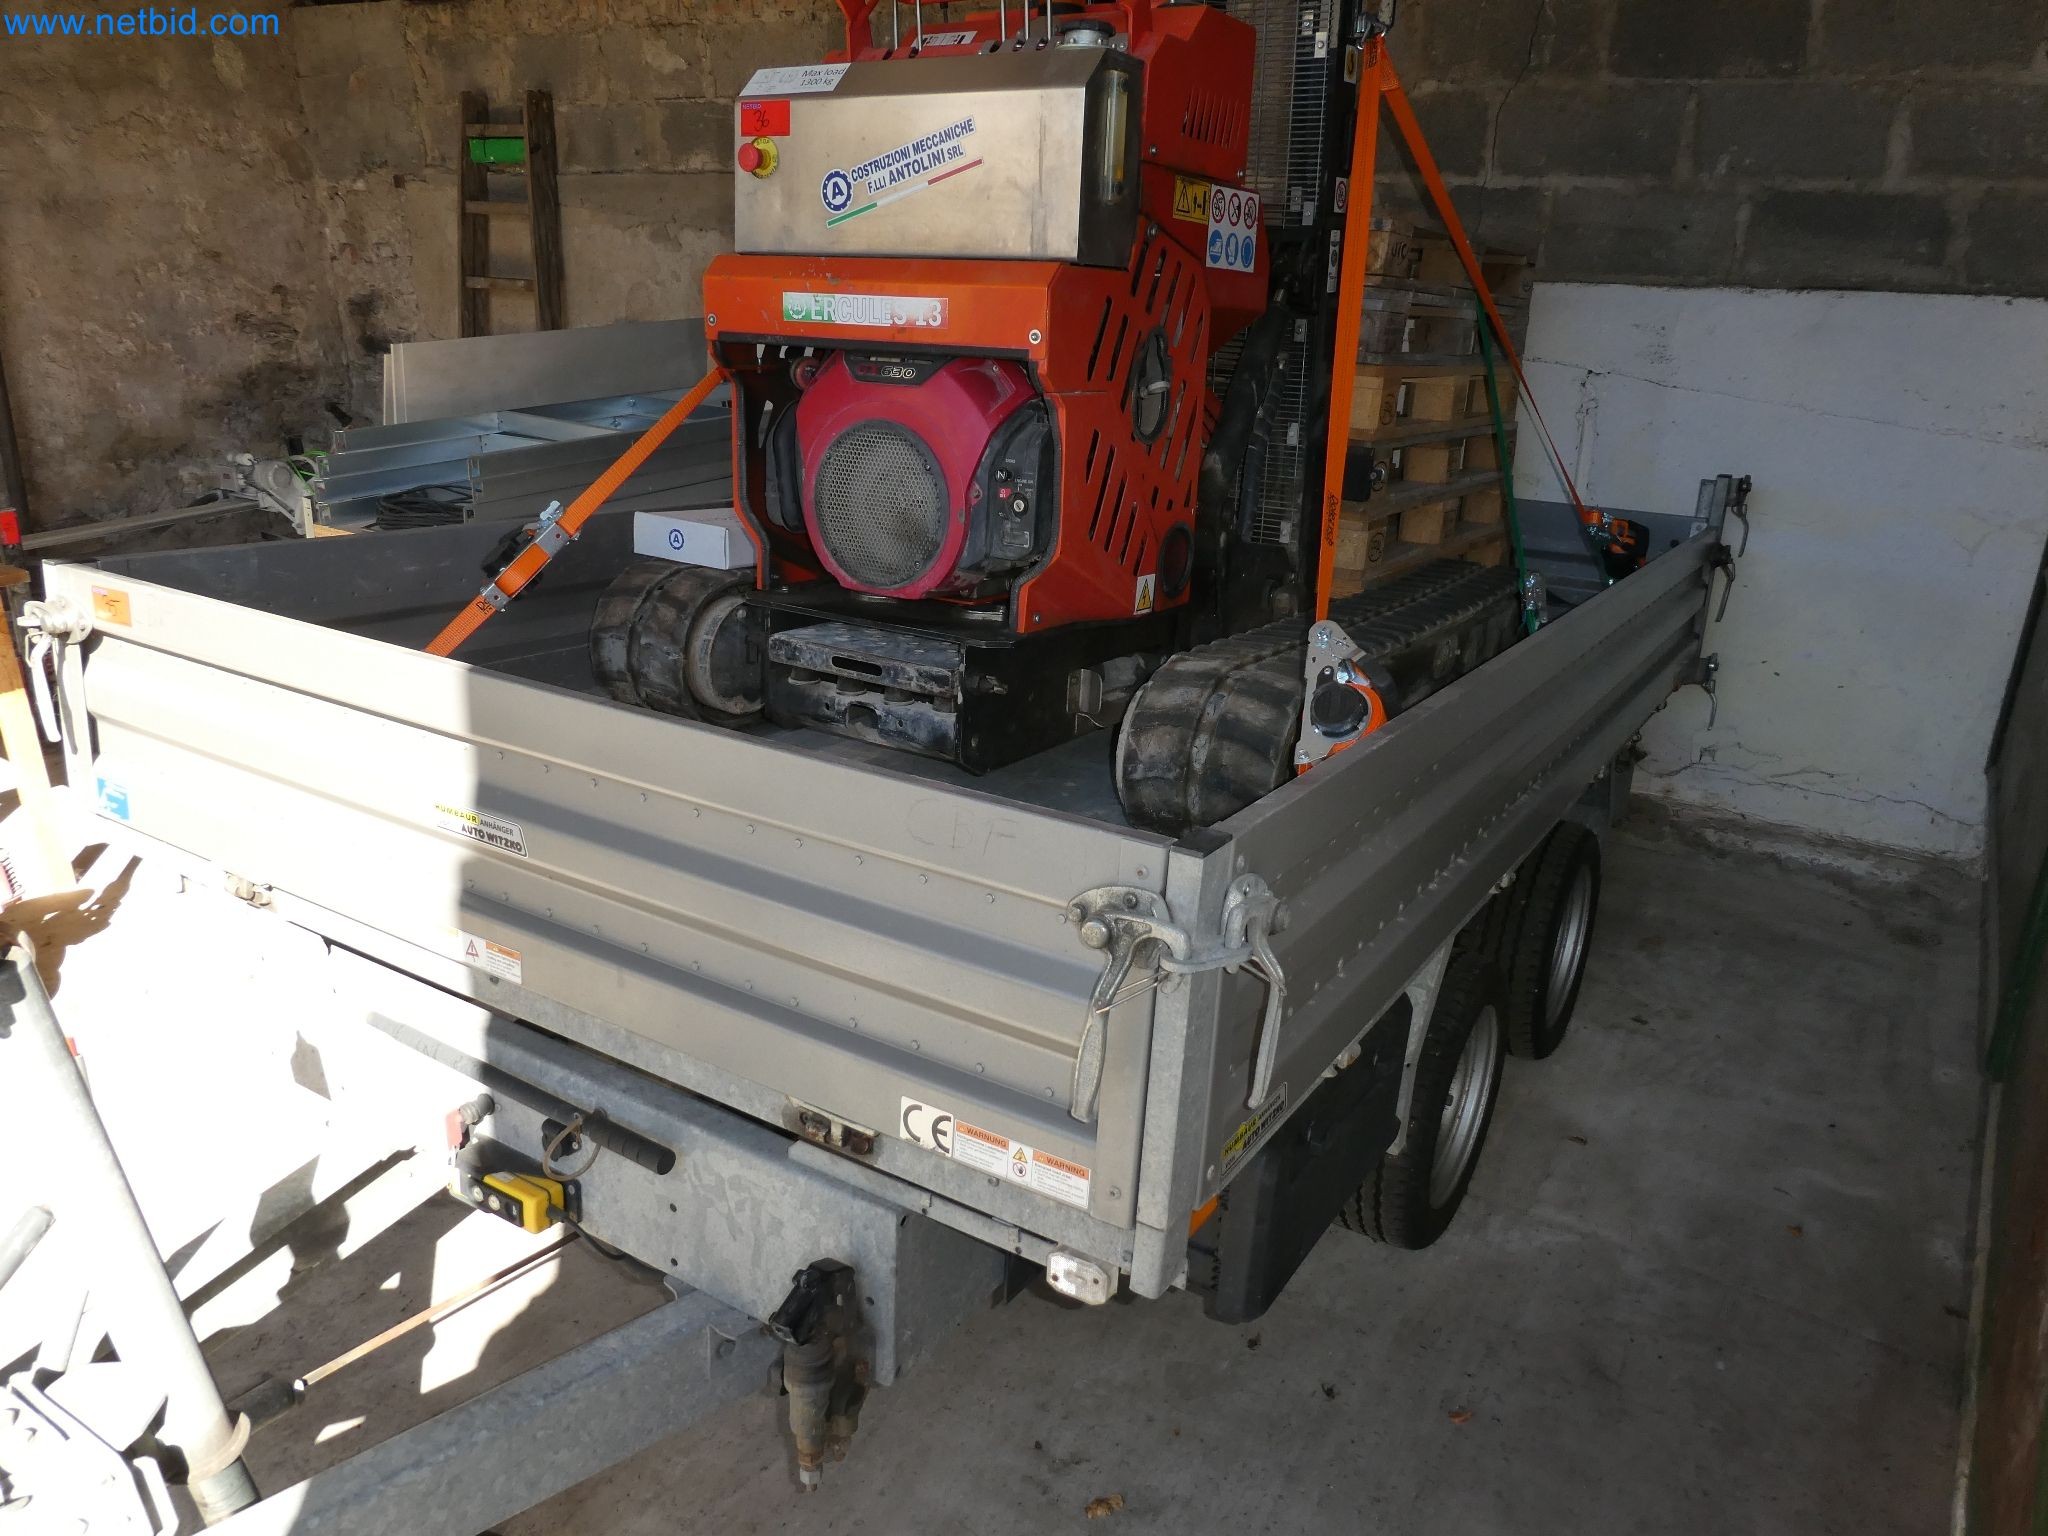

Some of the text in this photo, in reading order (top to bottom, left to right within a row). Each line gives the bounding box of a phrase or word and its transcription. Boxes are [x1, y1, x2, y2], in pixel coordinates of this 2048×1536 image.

[800, 78, 835, 87] 1300 kg
[801, 67, 847, 78] Max load
[753, 110, 770, 131] 36
[851, 118, 974, 182] COSTRUZIONI MECCANICHE
[867, 144, 964, 194] F.LLI ANTOLINI SRL
[881, 365, 916, 379] 630
[461, 823, 523, 853] AUTO WITZKO
[480, 818, 514, 837] ANHÄNGER
[902, 1103, 952, 1154] CE
[966, 1126, 1008, 1149] WARNUNG
[1046, 1157, 1086, 1178] WARNING
